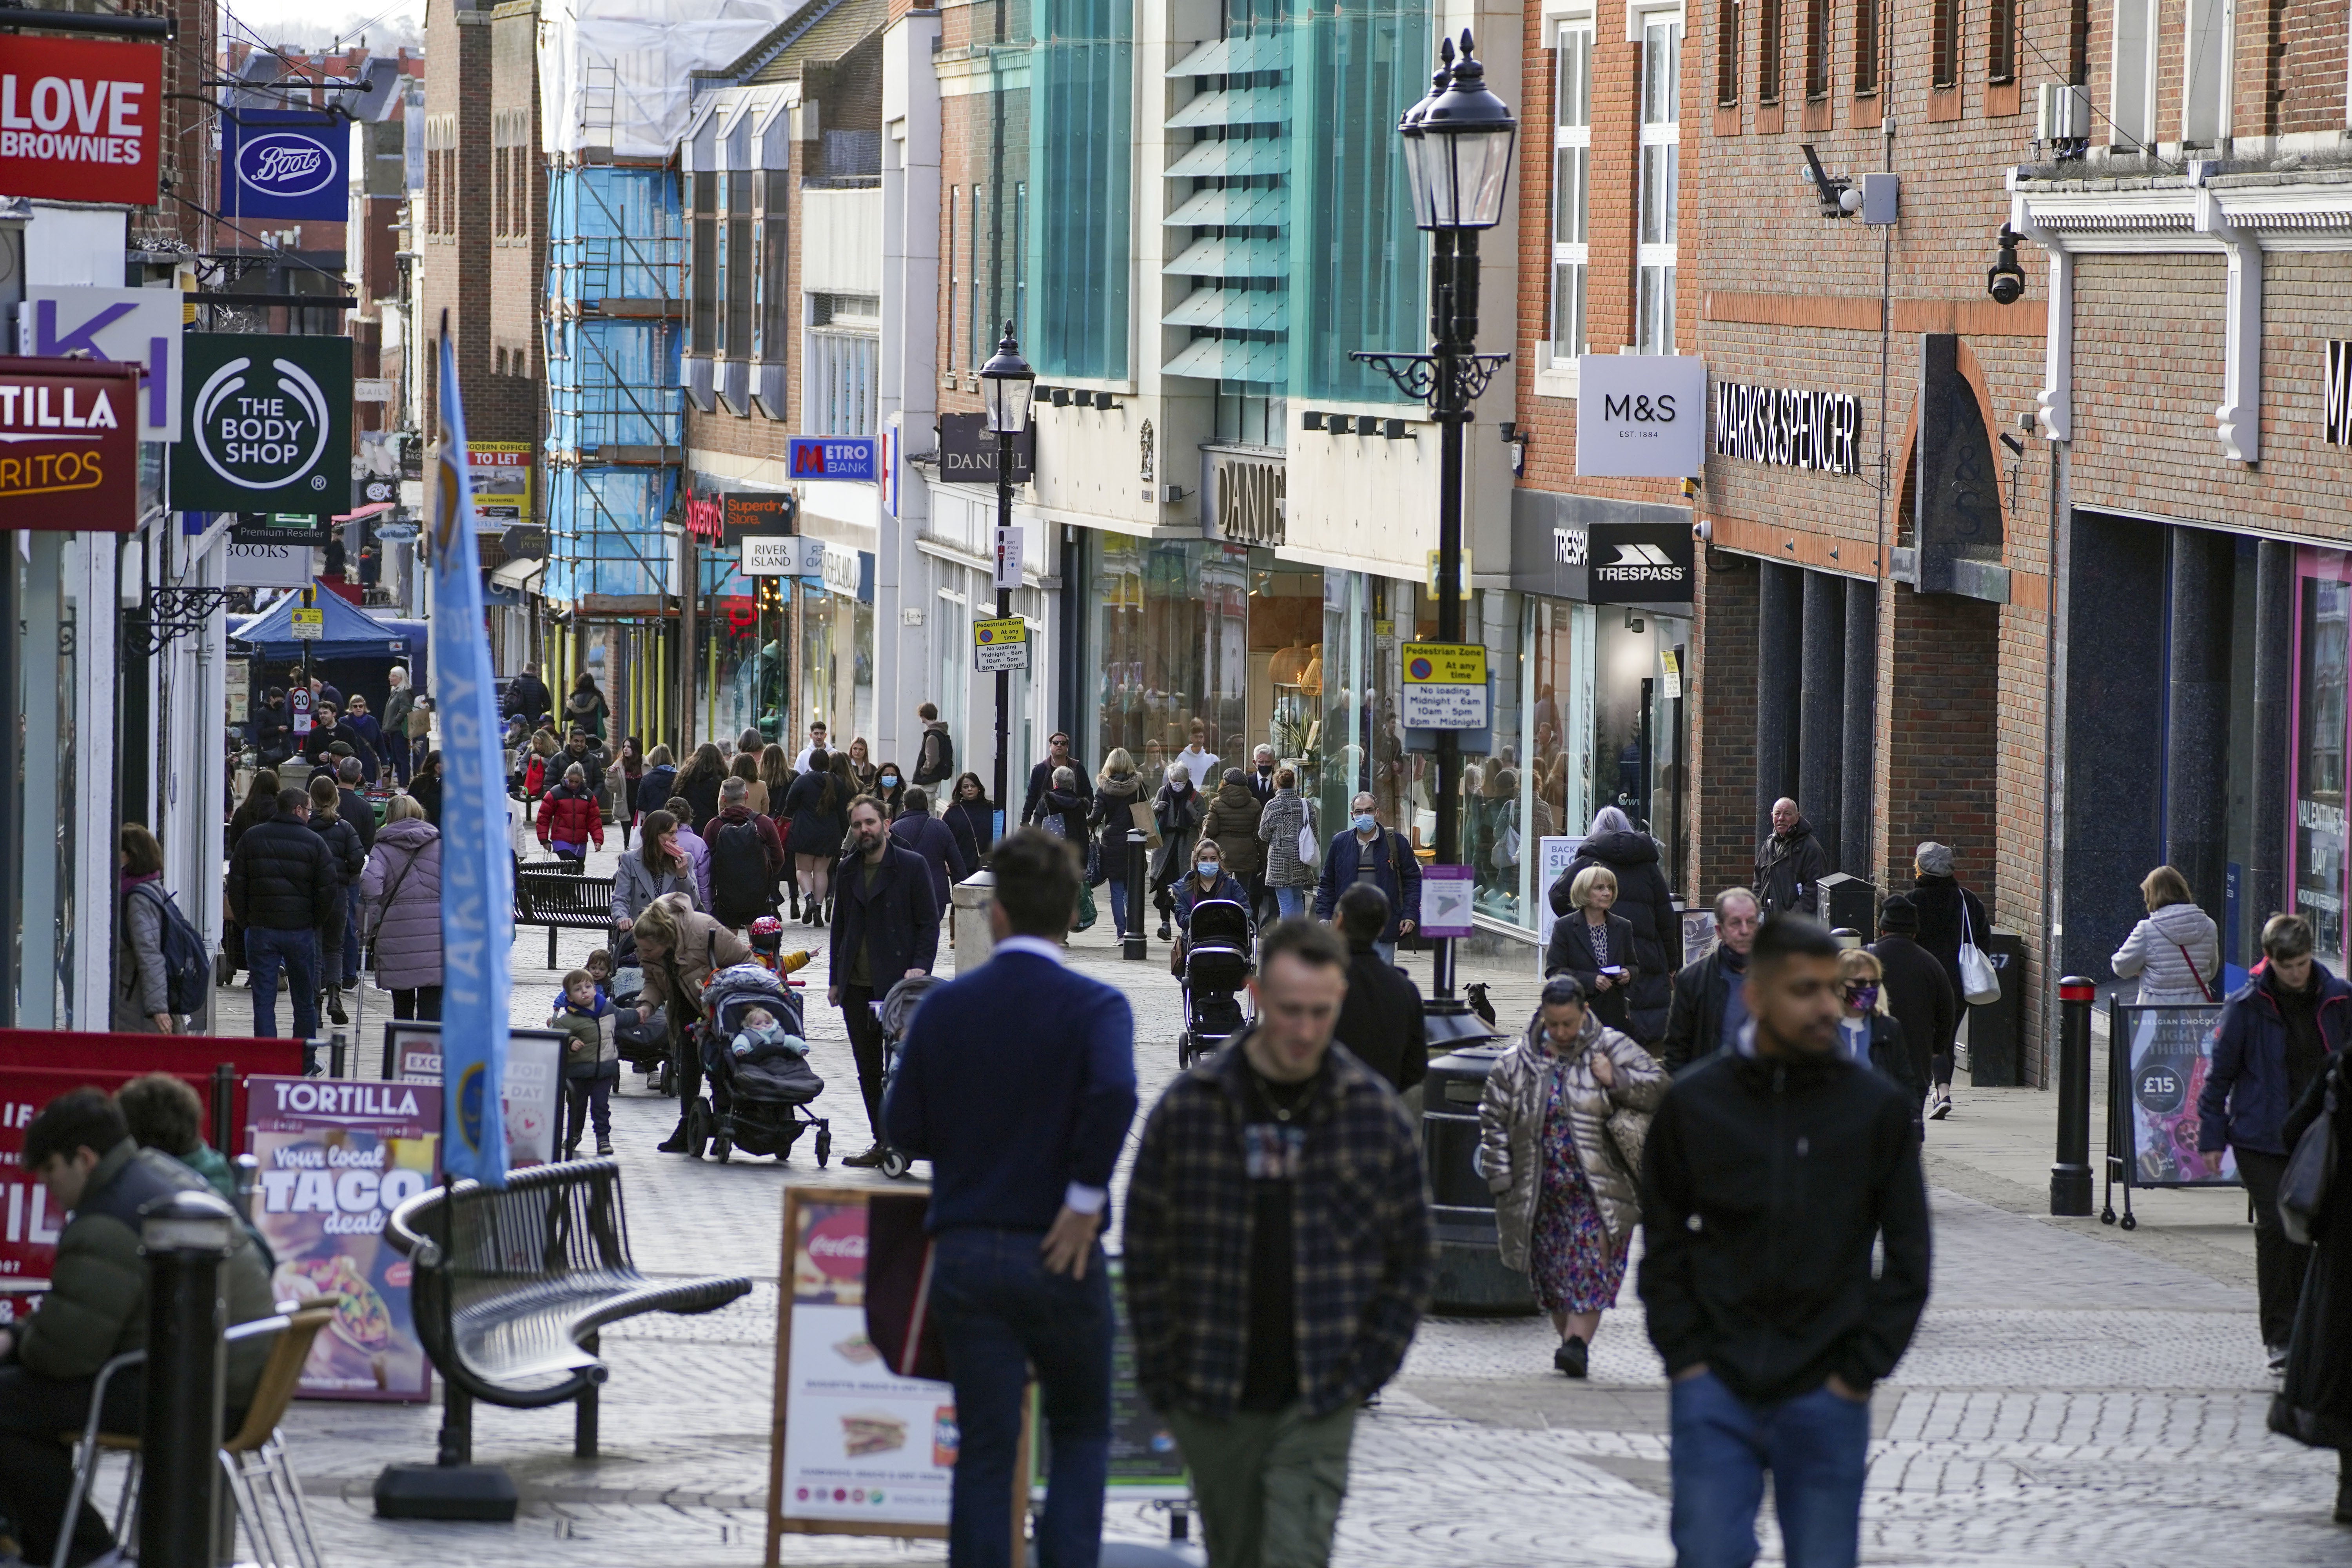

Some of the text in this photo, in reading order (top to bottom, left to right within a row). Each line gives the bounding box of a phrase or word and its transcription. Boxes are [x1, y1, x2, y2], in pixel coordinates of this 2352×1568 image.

[1, 74, 144, 137] LOVE
[0, 130, 142, 165] BROWNIES
[251, 146, 321, 182] Boots
[237, 397, 284, 416] THE
[1605, 394, 1675, 422] M&S
[221, 418, 303, 441] BODY
[1716, 381, 1855, 474] MARKS & SPENCER
[225, 442, 299, 464] SHOP
[475, 452, 519, 465] TO LET
[795, 445, 868, 473] METRO
[828, 462, 867, 473] BANK
[947, 453, 1027, 469] DANL
[727, 499, 784, 514] Superdry
[727, 512, 760, 524] Store.
[240, 527, 324, 538] Premium Reseller
[226, 543, 289, 558] BOOKS
[755, 545, 787, 555] RIVER
[751, 557, 791, 566] ISLAND
[1595, 567, 1683, 581] TRESPASS
[1406, 646, 1481, 656] Pedestrian Zone
[1459, 662, 1476, 671] any
[1436, 686, 1470, 696] loading
[295, 695, 308, 706] 20
[1410, 696, 1450, 706] Midnight
[1452, 708, 1473, 716] 5pm
[1439, 718, 1481, 726] Midnight
[2312, 848, 2327, 877] DAY
[513, 1064, 543, 1077] FOR
[511, 1085, 543, 1098] DAY
[2144, 1076, 2175, 1093] £15
[274, 1082, 420, 1116] TORTILLA
[274, 1144, 386, 1169] Your local
[261, 1168, 425, 1213] TACO
